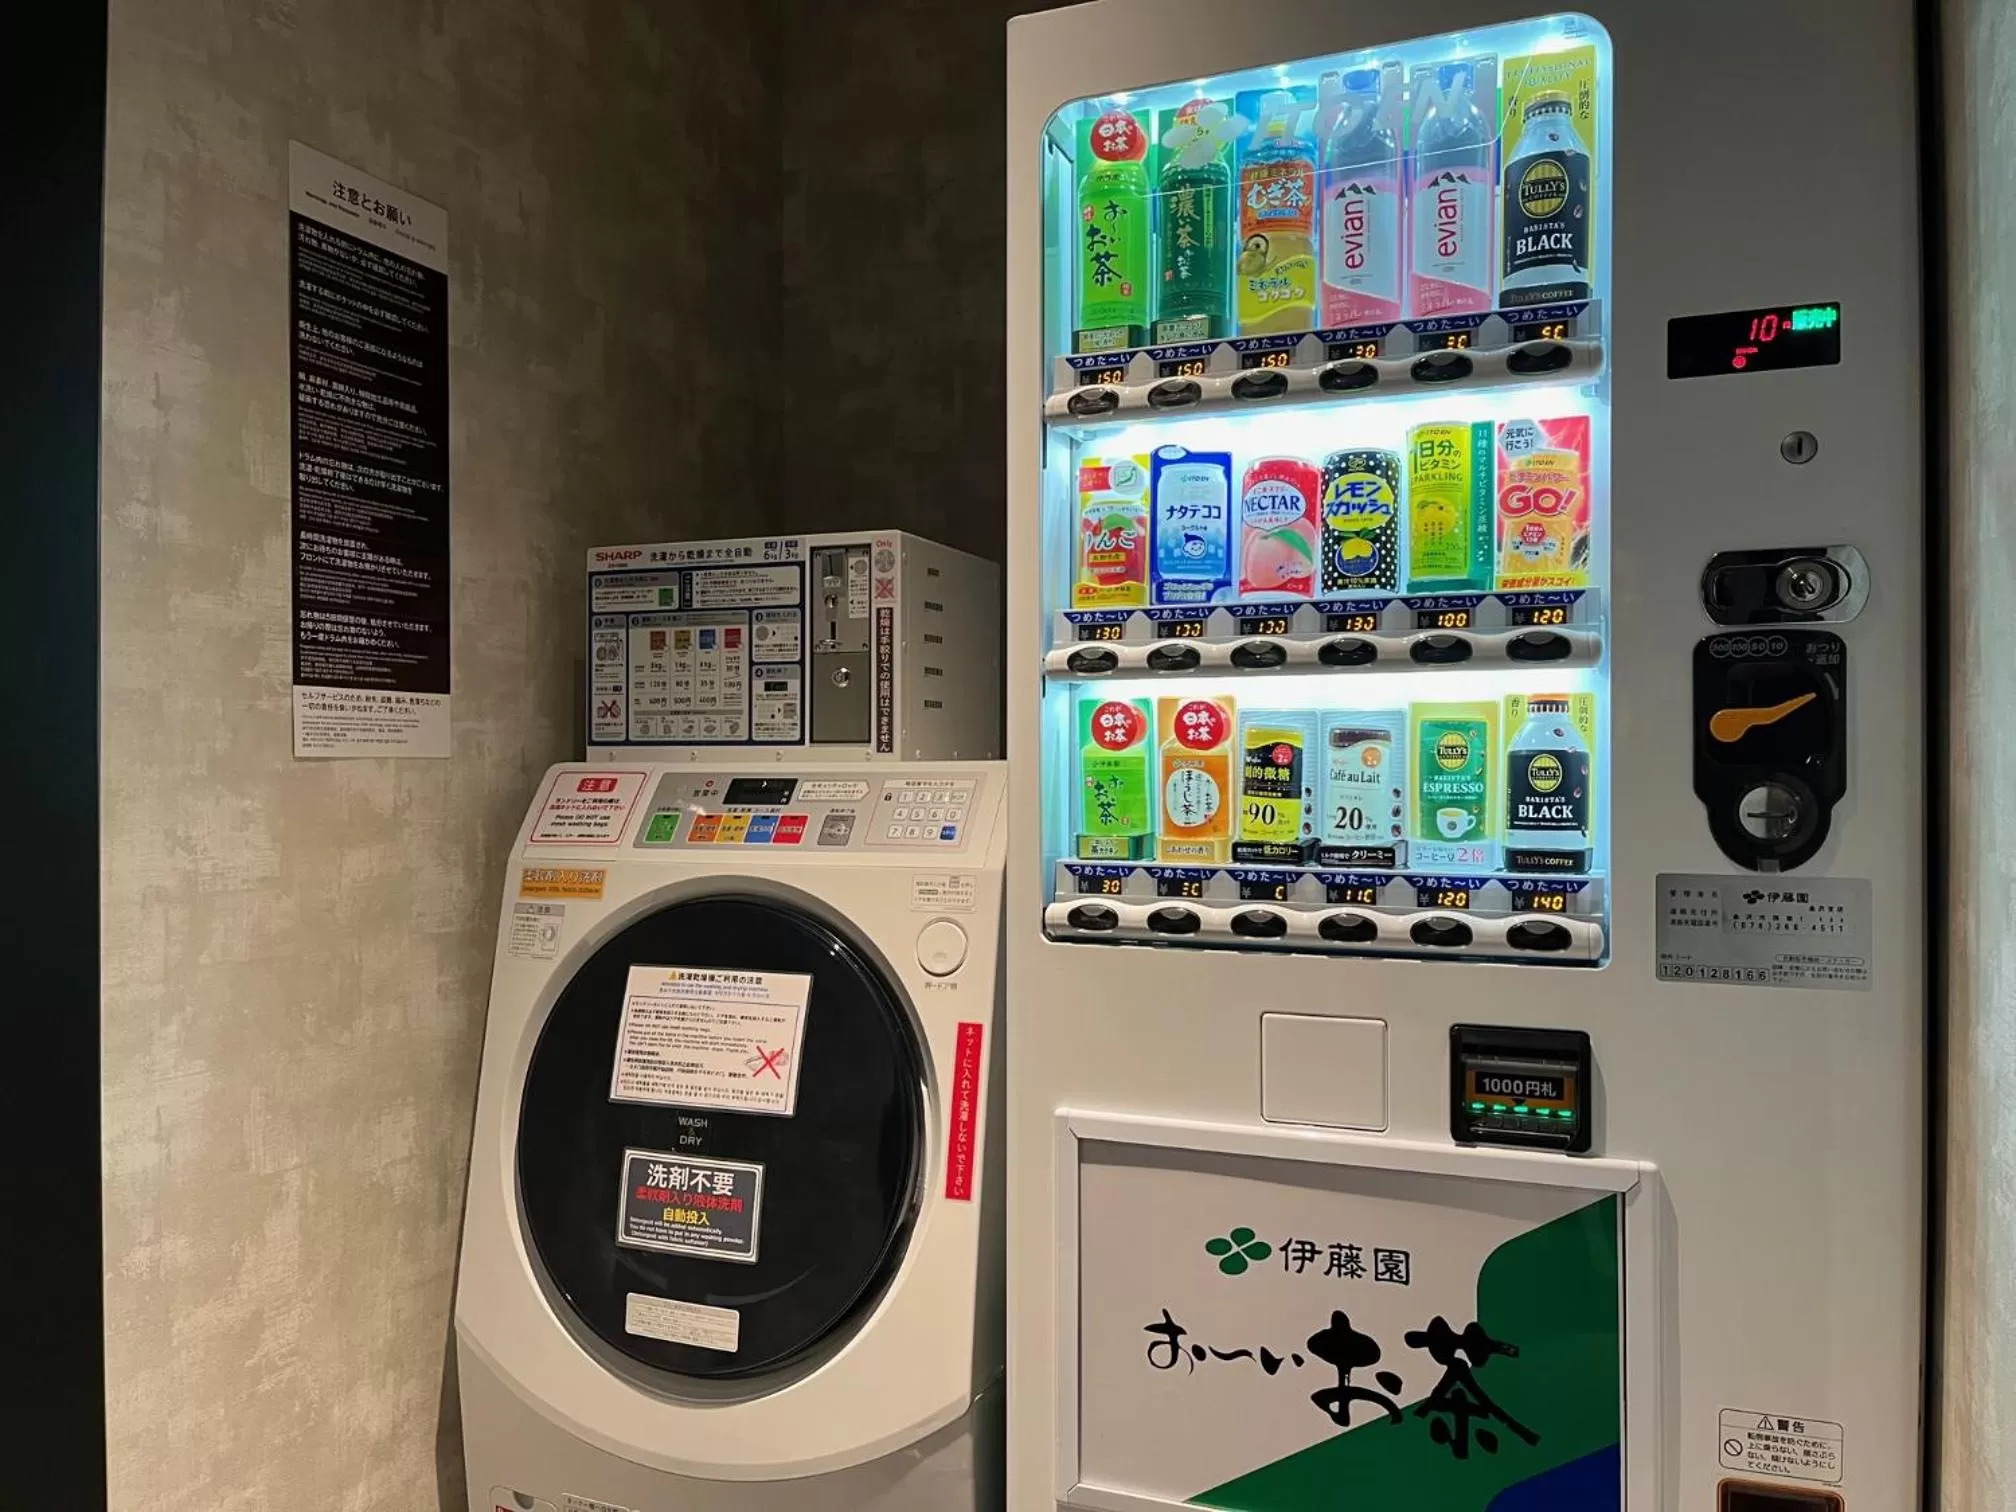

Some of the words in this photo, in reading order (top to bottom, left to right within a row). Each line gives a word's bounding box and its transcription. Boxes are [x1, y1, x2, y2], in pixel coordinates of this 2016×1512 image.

[1246, 178, 1312, 209] むぎ茶
[332, 180, 412, 226] 注意とお願い
[1434, 188, 1458, 258] evian
[1341, 199, 1364, 270] evian
[1515, 232, 1573, 256] BLACK
[1085, 223, 1123, 287] お茶
[1261, 353, 1288, 367] 150
[1097, 370, 1122, 384] 150
[1177, 363, 1203, 376] 150
[1505, 427, 1535, 439] 元気に
[1419, 459, 1462, 472] ビタミン
[1335, 481, 1382, 499] レモン
[1244, 495, 1301, 513] NECTAR
[1499, 484, 1577, 517] GO!
[1166, 504, 1222, 521] ナタデココ
[1325, 500, 1393, 518] スカッシュ
[595, 550, 643, 562] SHARP
[1438, 613, 1467, 627] 100
[1533, 608, 1563, 624] 120
[1096, 626, 1121, 639] 130
[1771, 641, 1784, 649] 10
[1103, 728, 1128, 742] お茶
[1186, 726, 1213, 741] お茶
[1330, 768, 1347, 782] Café
[1347, 773, 1359, 783] au
[1360, 771, 1381, 784] Lait
[1181, 769, 1202, 817] ほうじ茶
[1422, 782, 1484, 793] ESPRESSO
[1518, 804, 1574, 819] BLACK
[1351, 849, 1393, 861] クリーミー
[1544, 856, 1575, 866] COFFEE
[1437, 891, 1467, 907] 120
[1533, 895, 1564, 910] 140
[1767, 892, 1809, 904] 伊藤園
[1482, 1077, 1557, 1097] 1000円札
[678, 1116, 708, 1128] WASH
[679, 1135, 703, 1147] DRY
[646, 1162, 735, 1196] 洗剤不要
[662, 1206, 710, 1226] 自動投入
[1278, 1237, 1411, 1286] 伊藤園
[1777, 1418, 1805, 1434] 警告
